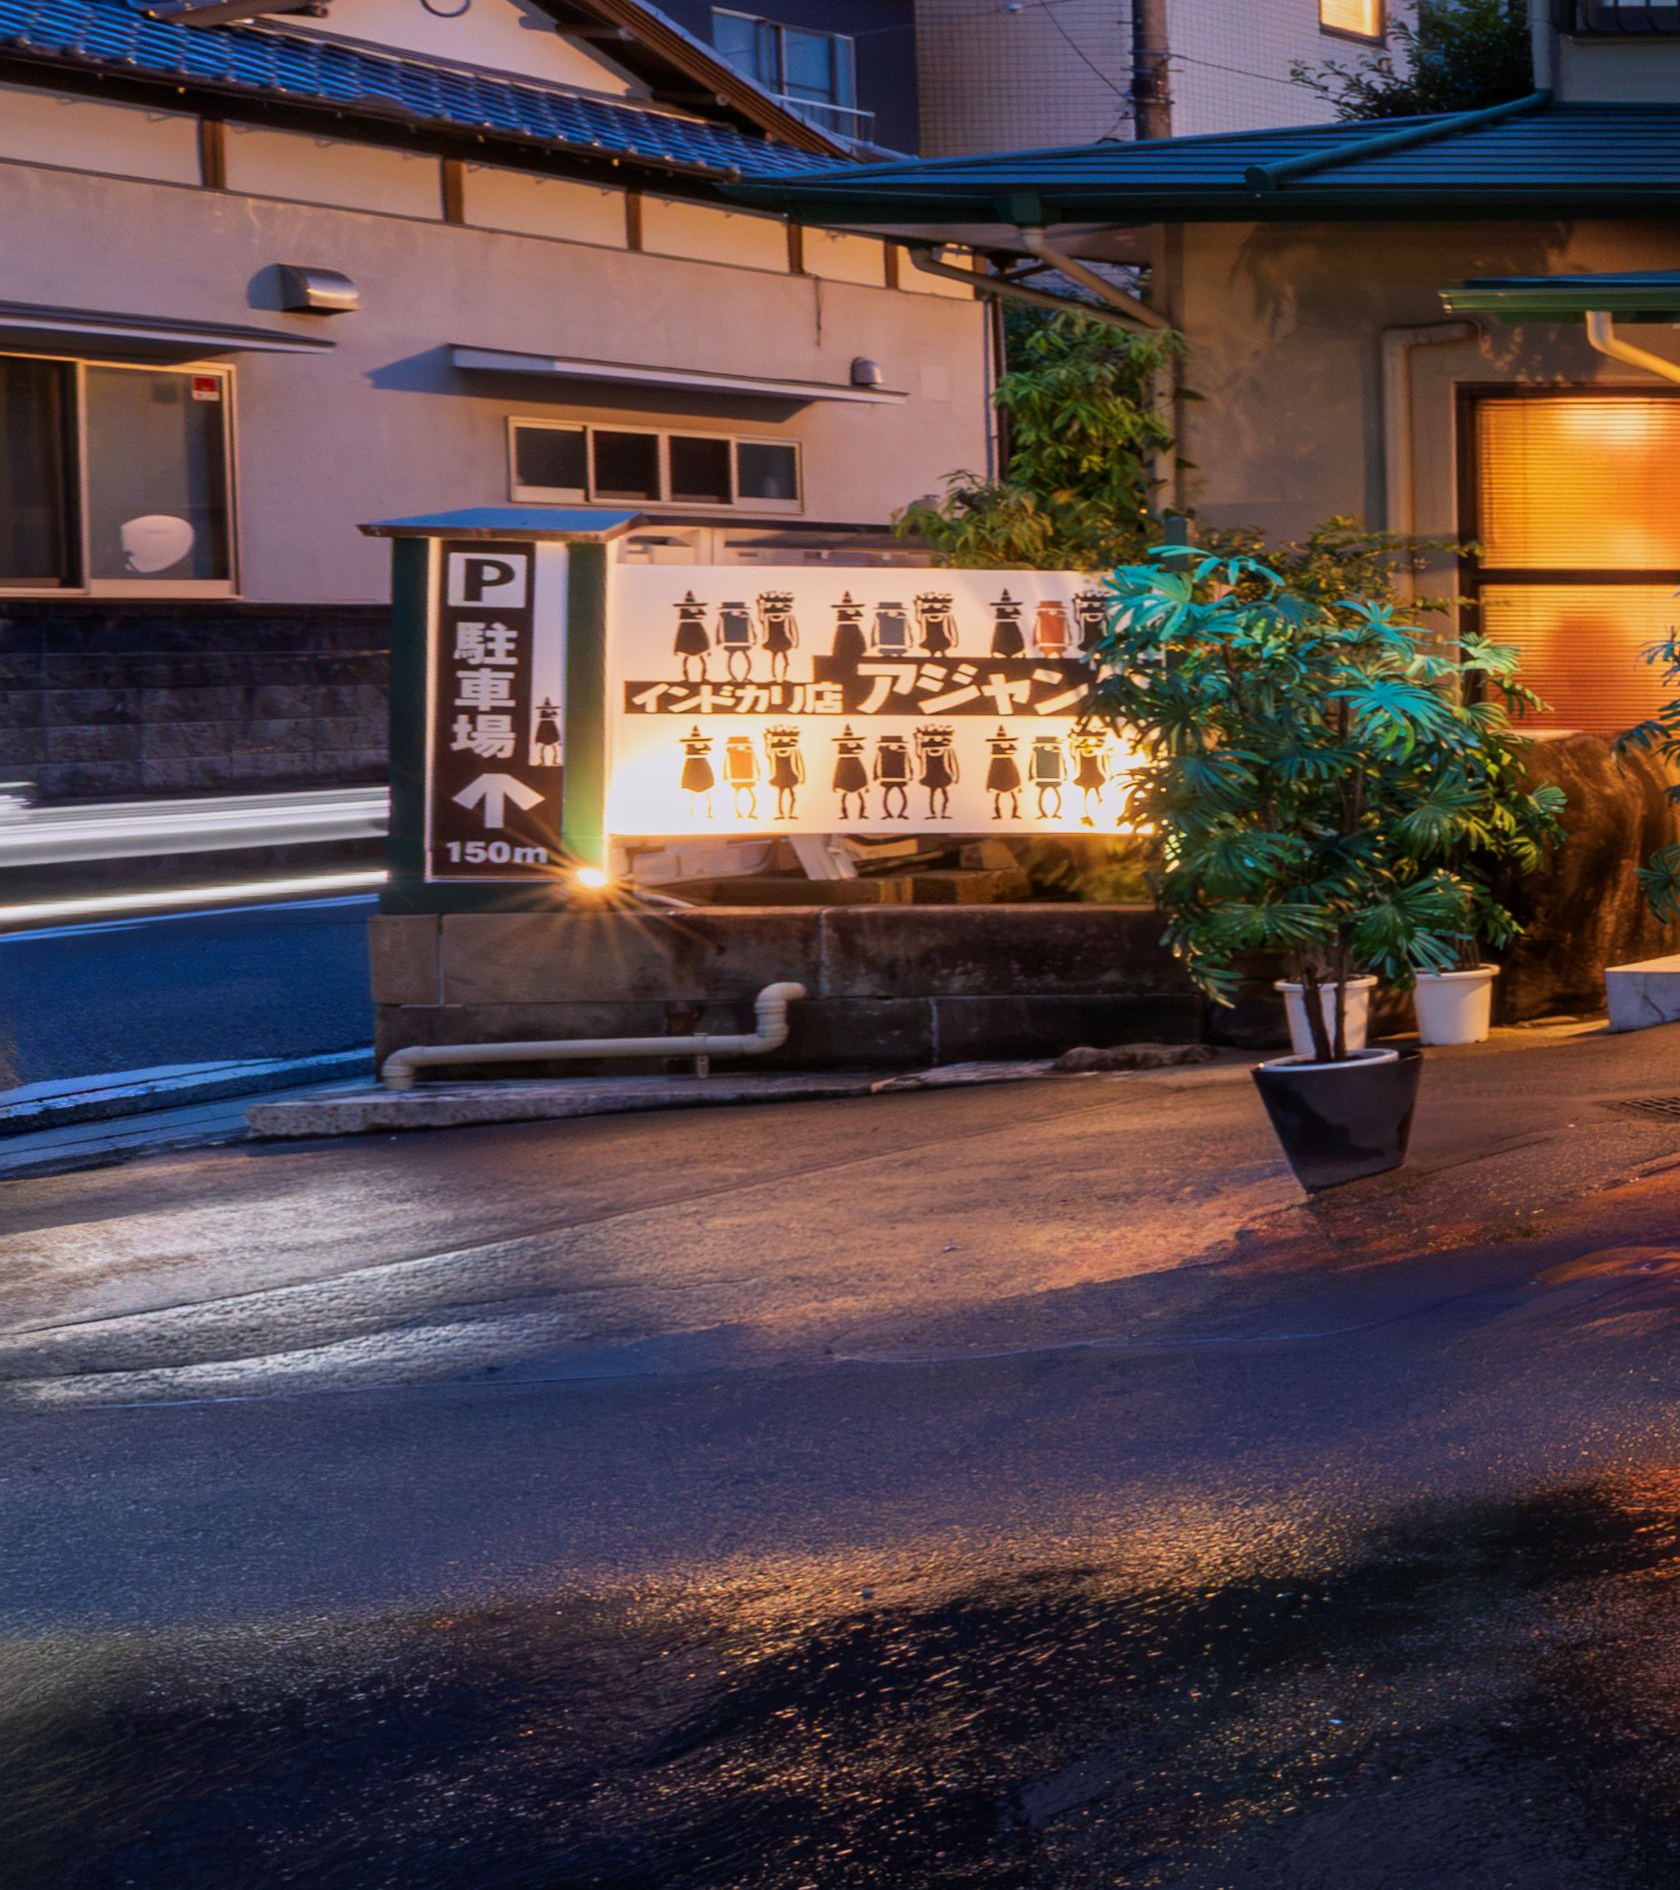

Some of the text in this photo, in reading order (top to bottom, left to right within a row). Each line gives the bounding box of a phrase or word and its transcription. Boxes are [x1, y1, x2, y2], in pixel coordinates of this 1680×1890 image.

[464, 559, 515, 602] P
[451, 621, 519, 759] 駐車場
[632, 681, 845, 714] インドカリ店
[857, 662, 1150, 715] アジャン
[447, 841, 549, 863] 150m
